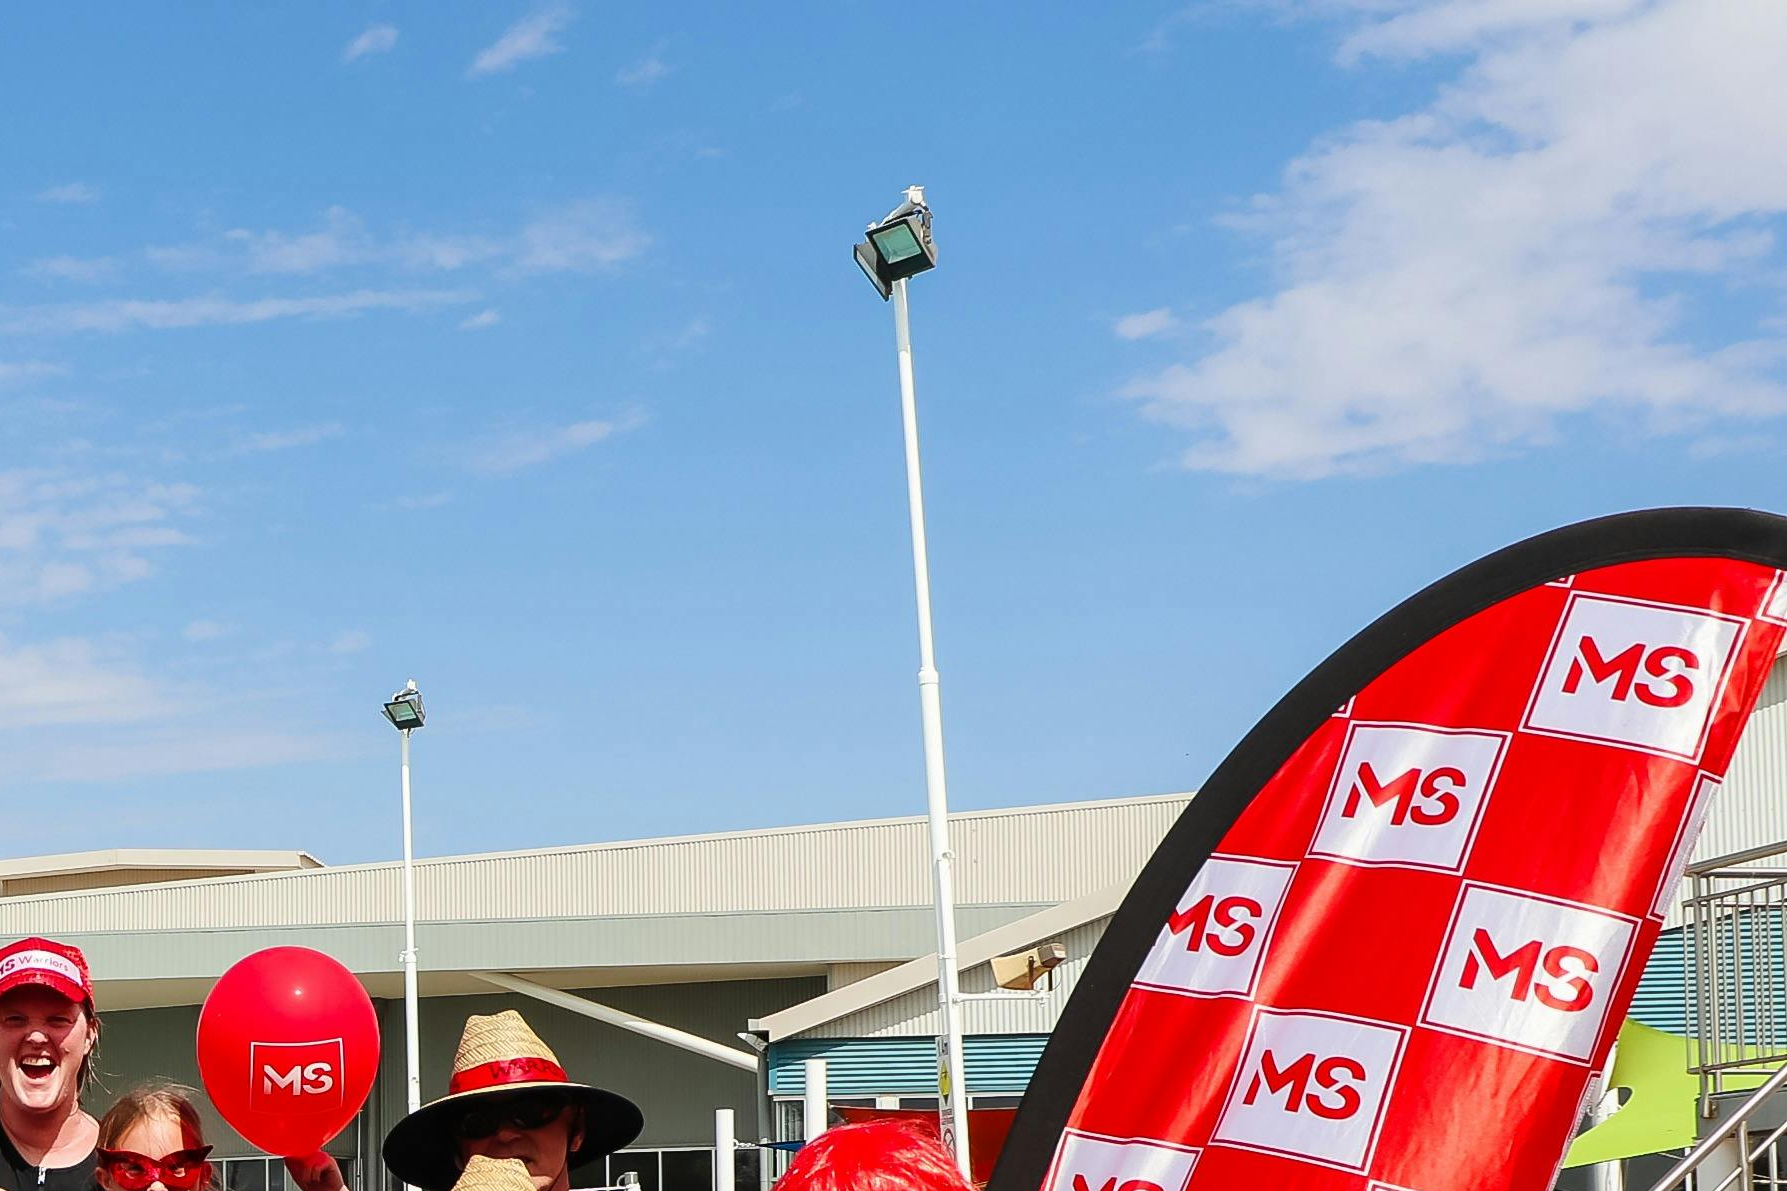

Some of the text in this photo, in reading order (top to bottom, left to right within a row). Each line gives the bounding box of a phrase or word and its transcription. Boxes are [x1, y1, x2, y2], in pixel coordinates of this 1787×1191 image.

[1563, 636, 1700, 708] MS
[1342, 761, 1467, 827] MS
[1154, 894, 1263, 957] MS
[18, 955, 69, 972] Warriors
[1459, 928, 1600, 1012] MS
[262, 1062, 333, 1096] MS
[1243, 1048, 1366, 1120] MS
